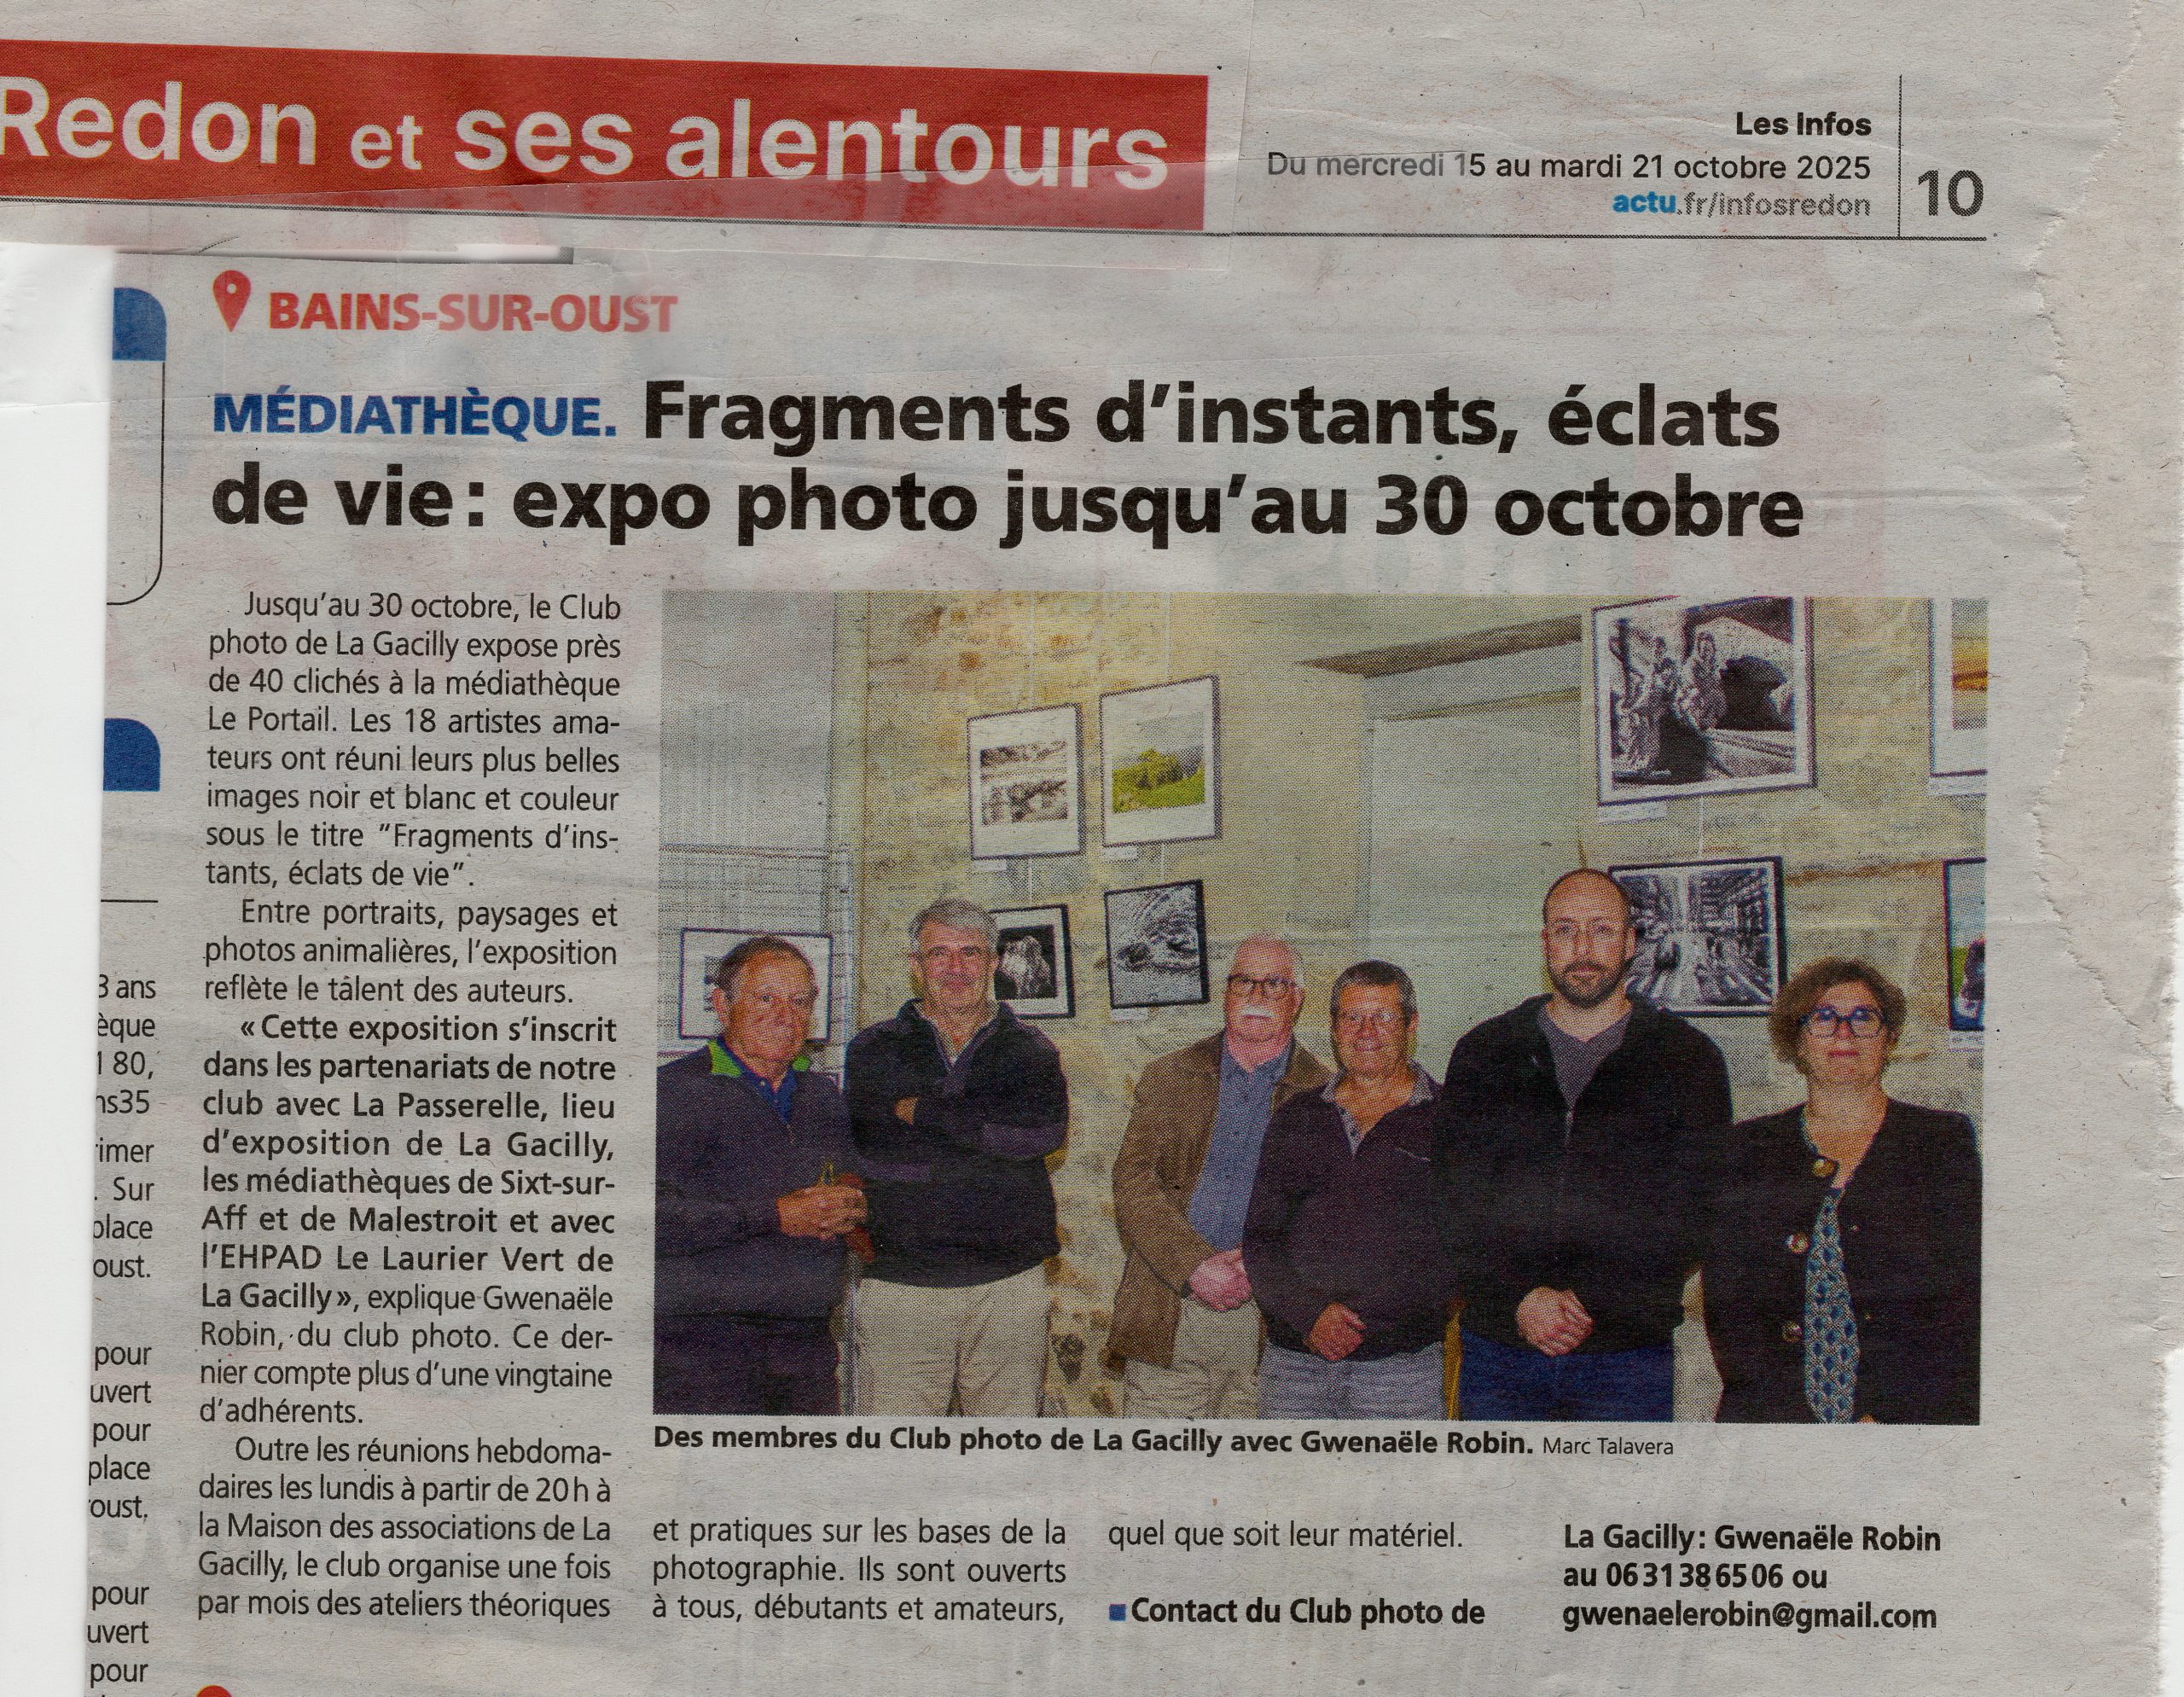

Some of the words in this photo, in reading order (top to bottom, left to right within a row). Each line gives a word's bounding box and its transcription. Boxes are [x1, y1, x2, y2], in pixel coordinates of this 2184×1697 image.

[0, 76, 317, 166] Redon
[351, 122, 424, 170] et
[454, 108, 634, 175] ses
[665, 98, 1170, 190] alentours
[1737, 112, 1788, 135] Les
[1798, 111, 1872, 136] Infos
[1268, 152, 1305, 176] Du
[1316, 153, 1443, 177] mercredi
[1455, 153, 1486, 177] 15
[1496, 158, 1530, 177] au
[1541, 154, 1622, 177] mardi
[1632, 154, 1663, 178] 21
[1674, 155, 1787, 179] octobre
[1797, 155, 1871, 180] 2025
[1612, 191, 1872, 218] actu.fr/infosredon
[1918, 169, 1984, 219] 10
[268, 292, 678, 334] BAINS-SUR-OUST
[214, 385, 616, 442] MÉDIATHÈQUE.
[646, 381, 1070, 457] Fragments
[1548, 383, 1780, 447] éclats
[212, 462, 307, 525] de
[514, 482, 710, 548] expo
[738, 467, 977, 546] photo
[1376, 474, 1467, 535] 30
[1496, 473, 1804, 539] octobre
[369, 592, 402, 617] 30
[410, 591, 520, 622] octobre,
[529, 592, 551, 619] le
[560, 592, 621, 620] Club
[209, 666, 240, 692] de
[249, 668, 282, 692] 40
[293, 667, 379, 694] clichés
[389, 670, 403, 694] à
[415, 669, 434, 694] la
[447, 669, 620, 702] médiathèque
[207, 746, 271, 770] teurs
[282, 747, 326, 770] ont
[336, 746, 400, 770] réuni
[412, 745, 473, 772] leurs
[484, 746, 536, 777] plus
[546, 747, 619, 773] belles
[241, 898, 310, 923] Entre
[324, 902, 443, 930] portraits,
[458, 906, 578, 933] paysages
[592, 904, 618, 927] et
[116, 980, 156, 999] ans
[206, 973, 288, 1000] reflète
[299, 975, 318, 1000] le
[328, 975, 404, 1002] talent
[414, 976, 457, 1002] des
[468, 979, 572, 1003] auteurs.
[113, 1051, 153, 1079] 80,
[204, 1050, 268, 1077] dans
[277, 1051, 311, 1078] les
[320, 1053, 489, 1084] partenariats
[497, 1053, 531, 1079] de
[540, 1057, 616, 1080] notre
[407, 1130, 442, 1156] de
[460, 1132, 491, 1156] La
[508, 1131, 613, 1163] Gacilly,
[113, 1177, 154, 1201] Sur
[201, 1204, 247, 1230] Aff
[259, 1208, 288, 1230] et
[301, 1205, 335, 1231] de
[350, 1206, 497, 1232] Malestroit
[510, 1211, 538, 1233] et
[551, 1215, 614, 1234] avec
[202, 1283, 230, 1307] La
[369, 1283, 475, 1316] explique
[484, 1285, 613, 1311] Gwenaële
[95, 1346, 152, 1371] pour
[201, 1365, 247, 1384] nier
[254, 1363, 351, 1391] compte
[359, 1360, 409, 1392] plus
[496, 1362, 612, 1393] vingtaine
[90, 1381, 151, 1404] uvert
[93, 1423, 151, 1448] pour
[235, 1436, 309, 1462] Outre
[317, 1436, 349, 1462] les
[358, 1438, 469, 1462] réunions
[478, 1437, 612, 1464] hebdoma-
[654, 1426, 703, 1447] Des
[712, 1426, 837, 1448] membres
[846, 1427, 880, 1449] du
[891, 1427, 950, 1449] Club
[961, 1427, 1042, 1455] photo
[1051, 1427, 1083, 1450] de
[1094, 1429, 1122, 1450] La
[1132, 1428, 1222, 1457] Gacilly
[1231, 1436, 1292, 1452] avec
[1301, 1431, 1438, 1453] Gwenaële
[1448, 1431, 1533, 1454] Robin.
[1543, 1438, 1590, 1454] Marc
[1597, 1437, 1673, 1455] Talavera
[89, 1454, 150, 1486] place
[200, 1511, 218, 1537] la
[229, 1513, 321, 1537] Maison
[330, 1513, 373, 1538] des
[381, 1514, 536, 1540] associations
[543, 1514, 575, 1540] de
[584, 1516, 610, 1541] La
[653, 1519, 678, 1541] et
[691, 1517, 812, 1548] pratiques
[823, 1524, 863, 1543] sur
[874, 1517, 907, 1543] les
[919, 1518, 990, 1546] bases
[1002, 1518, 1033, 1543] de
[1046, 1519, 1065, 1544] la
[1109, 1520, 1164, 1551] quel
[1175, 1526, 1223, 1551] que
[1234, 1520, 1280, 1546] soit
[1291, 1520, 1339, 1547] leur
[1350, 1522, 1462, 1547] matériel.
[1565, 1524, 1594, 1548] La
[1715, 1524, 1853, 1550] Gwenaële
[1863, 1525, 1941, 1551] Robin
[653, 1554, 844, 1587] photographie.
[859, 1555, 884, 1581] Ils
[897, 1560, 955, 1582] sont
[967, 1560, 1066, 1583] ouverts
[1564, 1567, 1596, 1586] au
[1792, 1570, 1827, 1589] ou
[92, 1586, 149, 1611] pour
[198, 1595, 240, 1620] par
[248, 1595, 309, 1614] mois
[317, 1589, 361, 1615] des
[369, 1589, 462, 1616] ateliers
[469, 1590, 611, 1624] théoriques
[653, 1593, 666, 1618] à
[677, 1595, 741, 1622] tous,
[755, 1593, 887, 1619] débutants
[898, 1597, 923, 1620] et
[934, 1598, 1063, 1625] amateurs,
[1132, 1597, 1237, 1623] Contact
[1246, 1596, 1281, 1623] du
[1290, 1597, 1355, 1624] Club
[1361, 1598, 1443, 1630] photo
[1452, 1598, 1485, 1624] de
[88, 1621, 149, 1644] uvert
[1562, 1600, 1937, 1634] gwenaelerobin@gmail.com
[90, 1664, 148, 1688] pour
